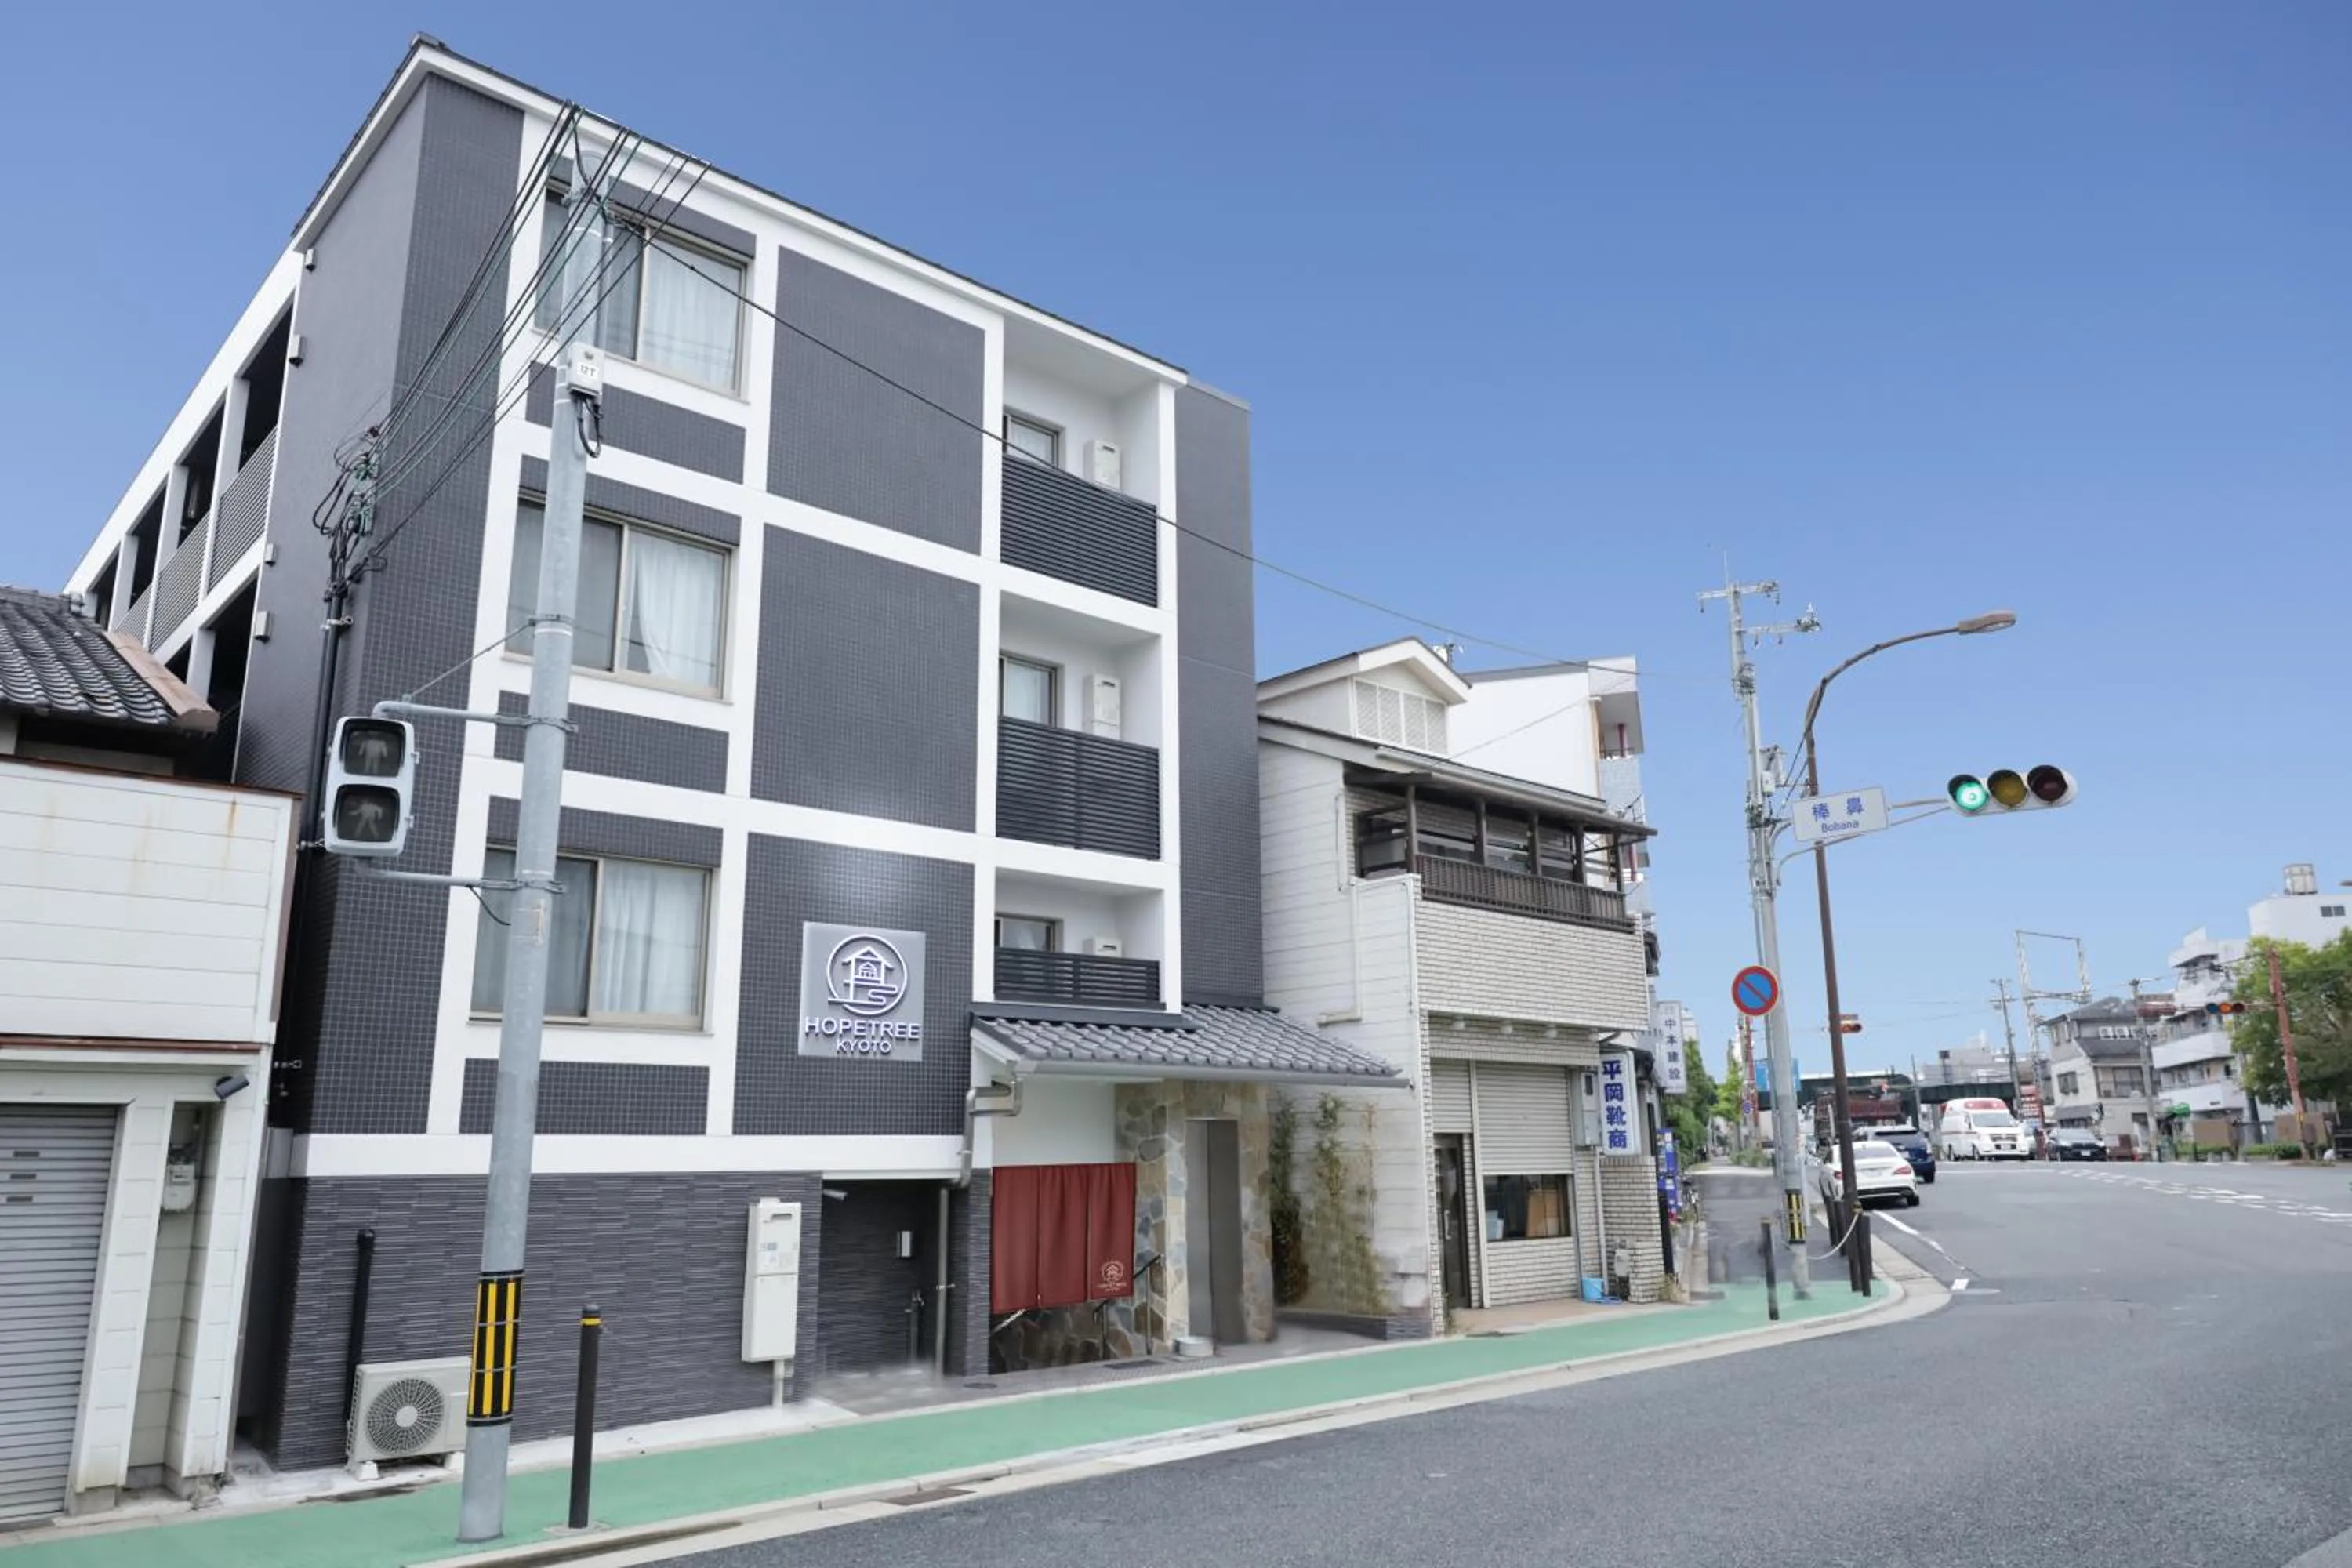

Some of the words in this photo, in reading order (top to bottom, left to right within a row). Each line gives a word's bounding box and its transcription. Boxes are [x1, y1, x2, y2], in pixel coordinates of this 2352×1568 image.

[805, 1016, 920, 1038] HOPETREE
[837, 1040, 891, 1053] KYOTO
[1602, 1059, 1627, 1149] 平岡靴商
